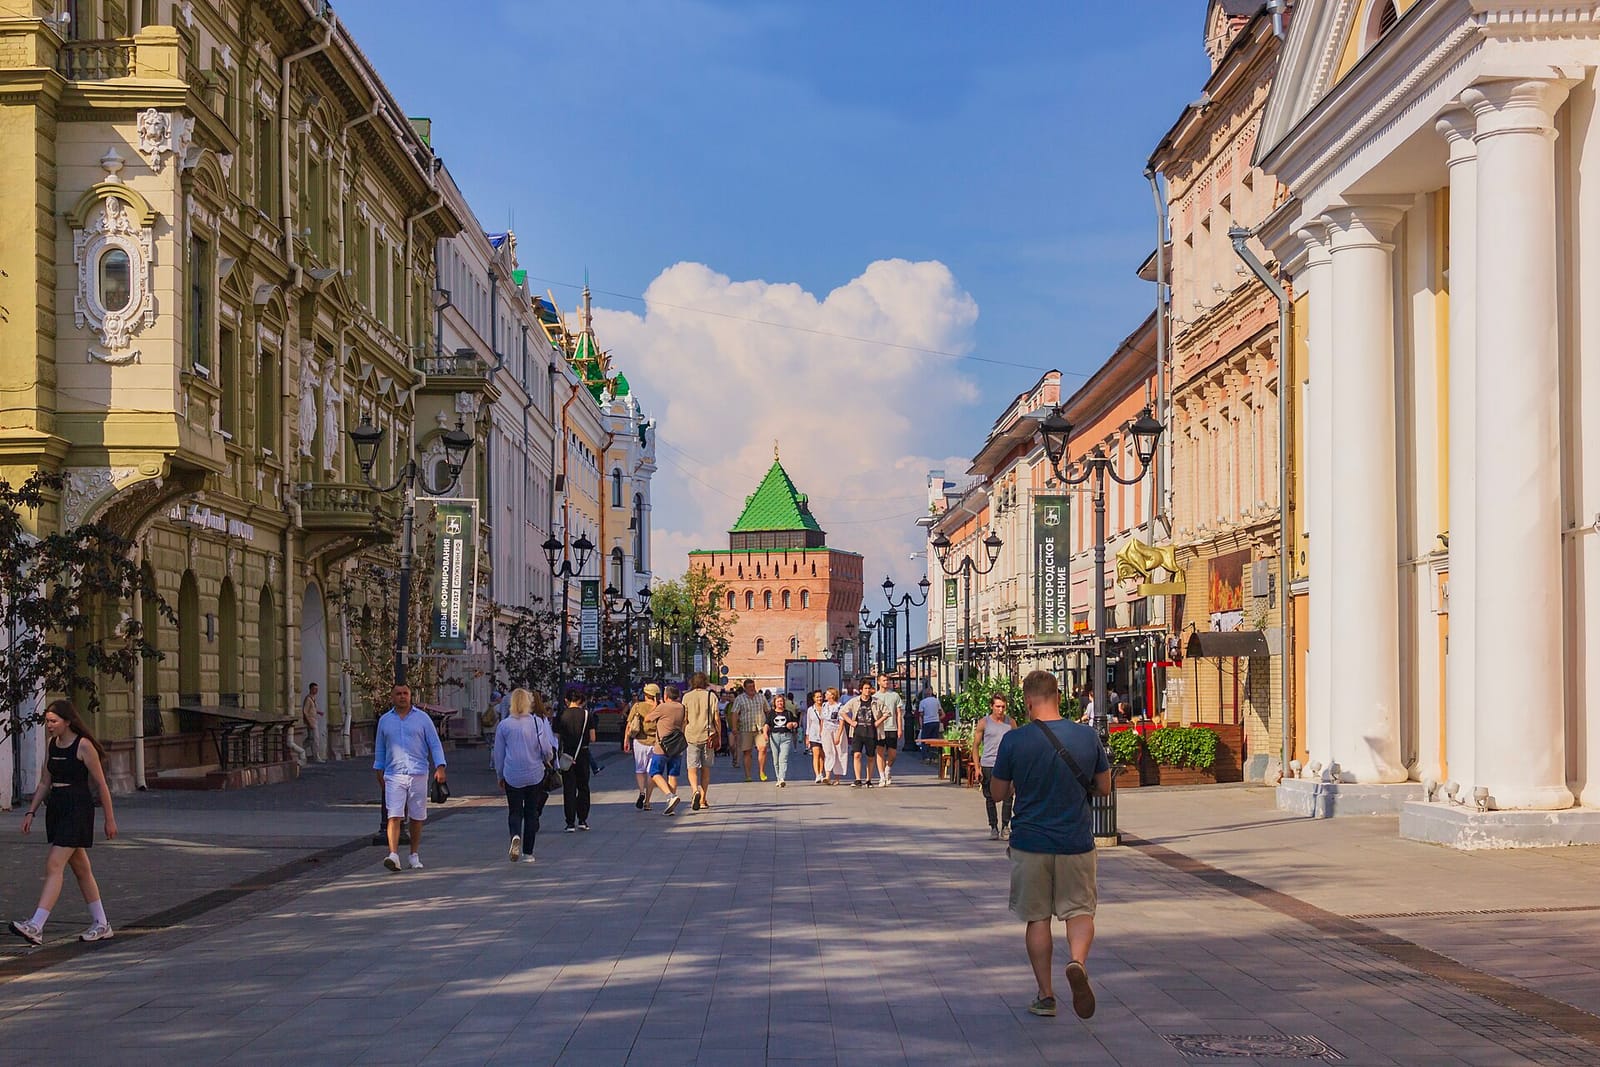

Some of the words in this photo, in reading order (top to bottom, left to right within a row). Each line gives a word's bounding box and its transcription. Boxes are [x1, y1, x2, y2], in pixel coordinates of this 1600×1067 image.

[441, 538, 451, 608] ФОРМИРОВАНИЯ
[1045, 536, 1055, 634] НИЖЕГОРОДСКОЕ
[1057, 566, 1066, 634] ОПОЛЧЕНИЕ
[440, 608, 448, 638] НОВЫЕ
